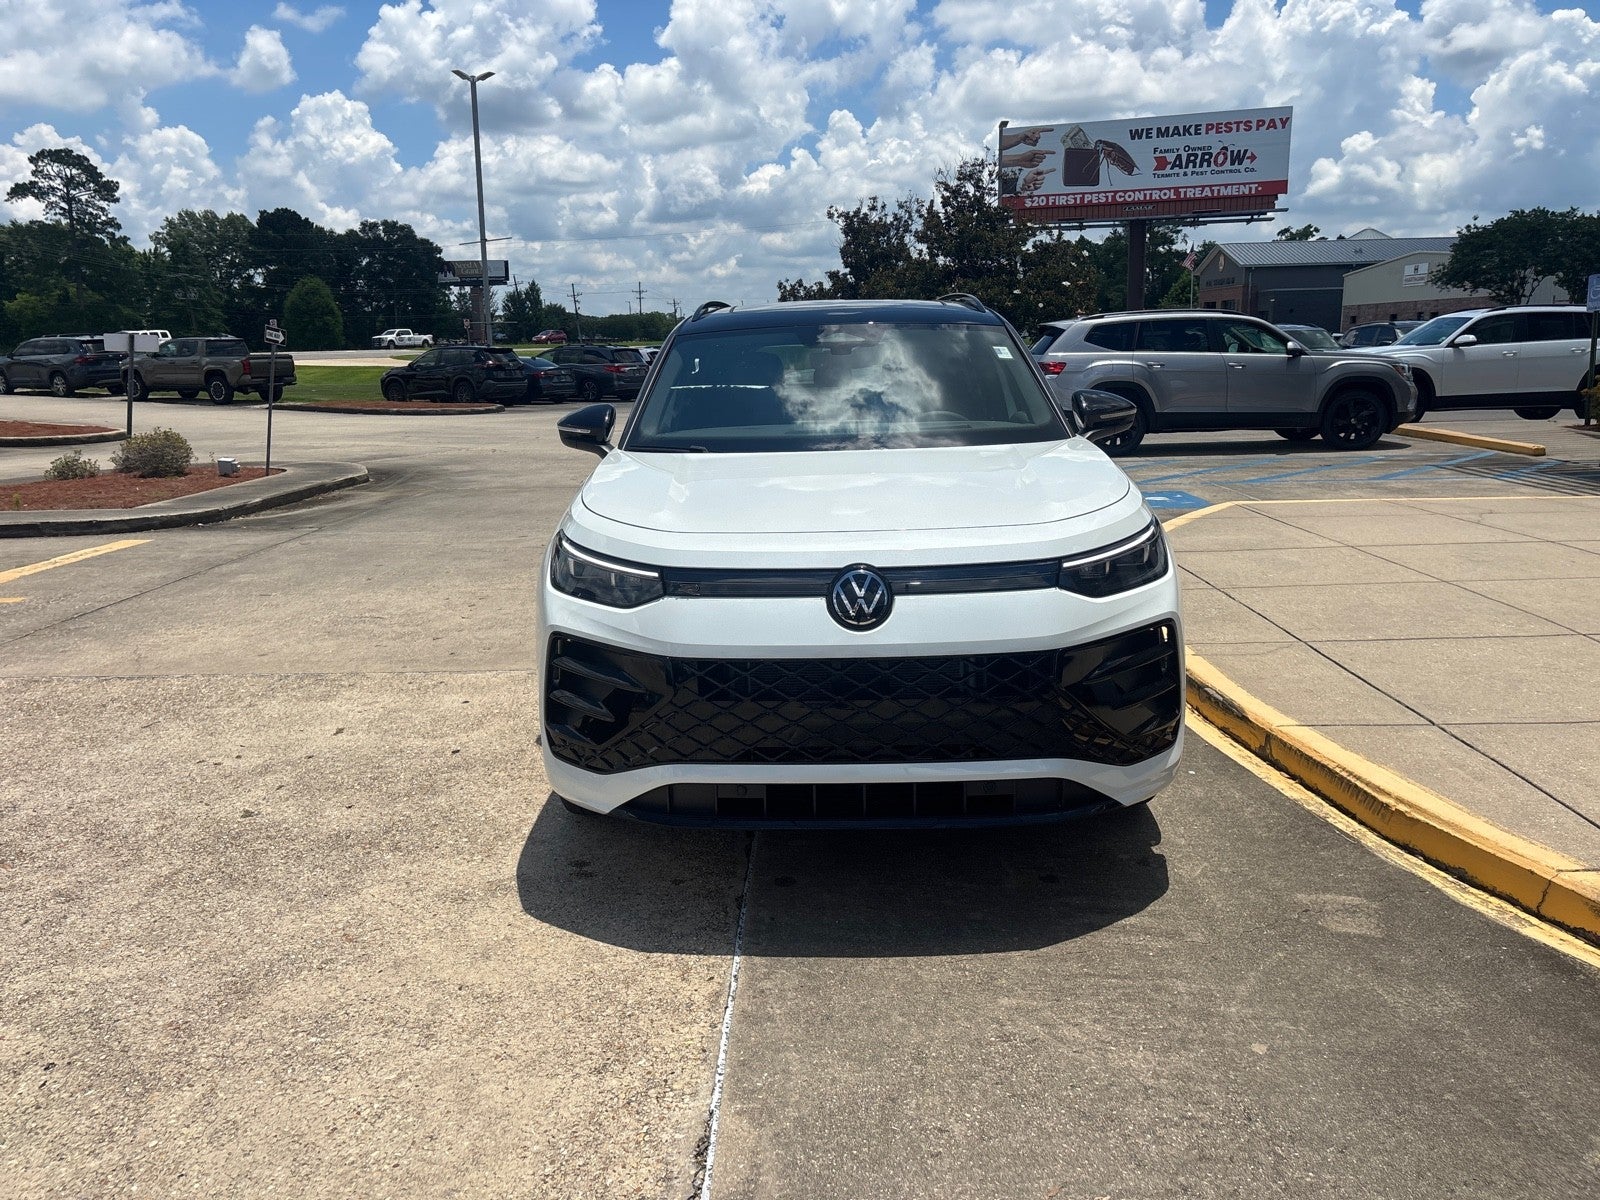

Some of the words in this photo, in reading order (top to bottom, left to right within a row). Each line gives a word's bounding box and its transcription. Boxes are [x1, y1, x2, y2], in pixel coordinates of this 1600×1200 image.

[1129, 127, 1153, 140] WE
[1156, 124, 1202, 138] MAKE
[1205, 119, 1253, 135] PESTS
[1255, 117, 1290, 131] PAY
[1170, 149, 1249, 170] ARROW
[1024, 195, 1048, 208] $20
[1049, 193, 1083, 206] FIRST
[1084, 190, 1114, 204] PEST
[1115, 187, 1177, 202] CONTROL
